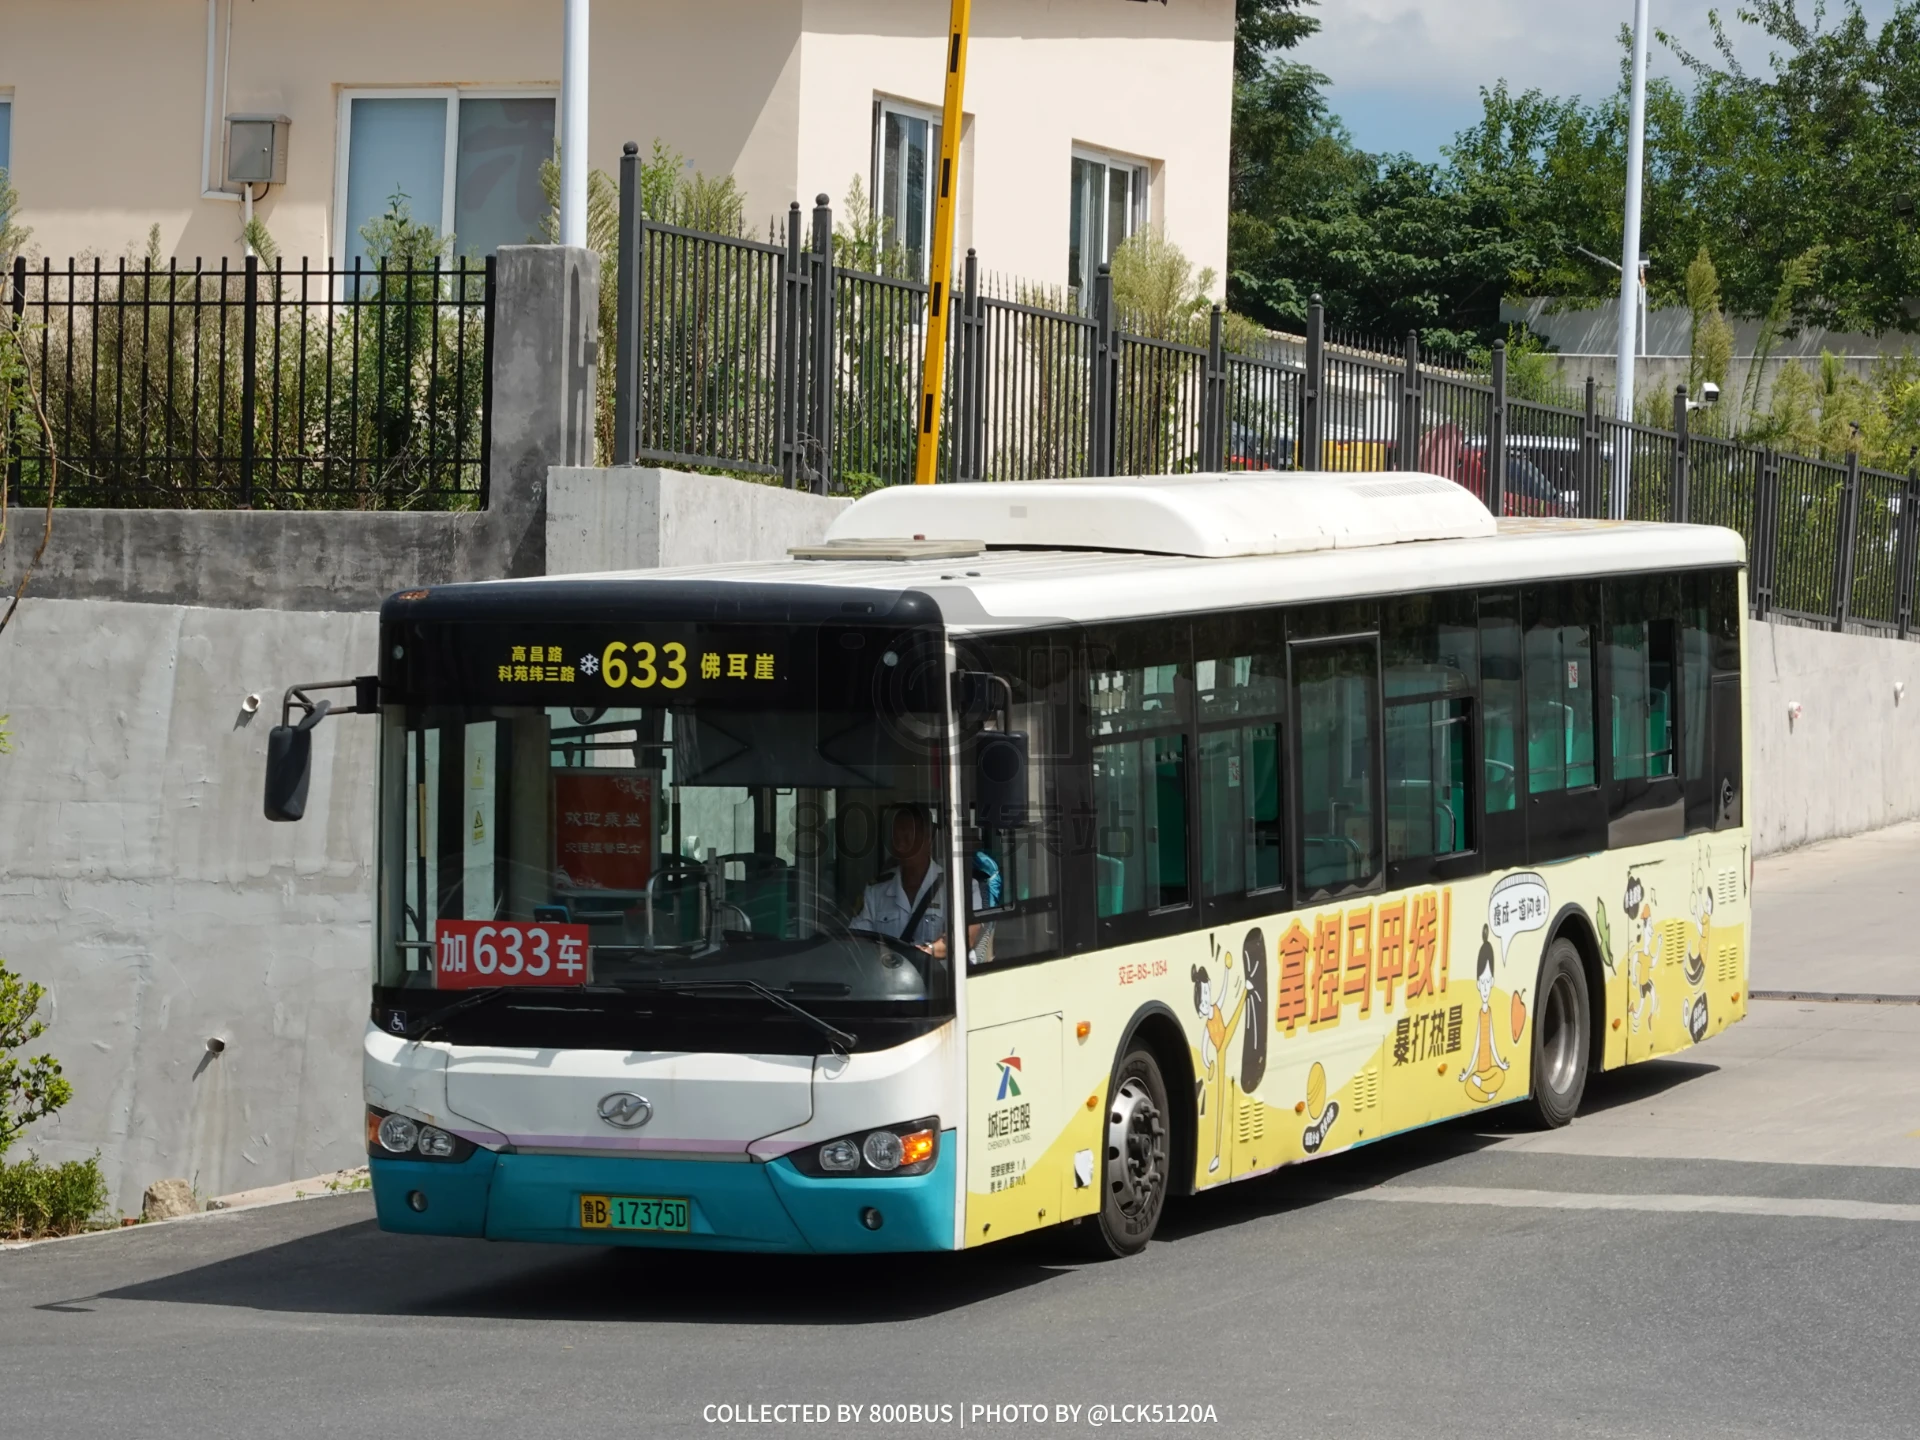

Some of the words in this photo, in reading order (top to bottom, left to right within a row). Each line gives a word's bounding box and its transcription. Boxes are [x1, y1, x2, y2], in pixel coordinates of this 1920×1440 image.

[511, 646, 562, 663] 高昌路
[602, 641, 687, 688] 633
[701, 653, 775, 680] 佛耳崖
[498, 665, 575, 683] 科苑纬三路
[564, 811, 642, 828] 欢迎乘坐
[441, 926, 583, 978] 加633车
[1393, 1004, 1463, 1067] 暴打热量
[987, 1102, 1031, 1139] 城运控股
